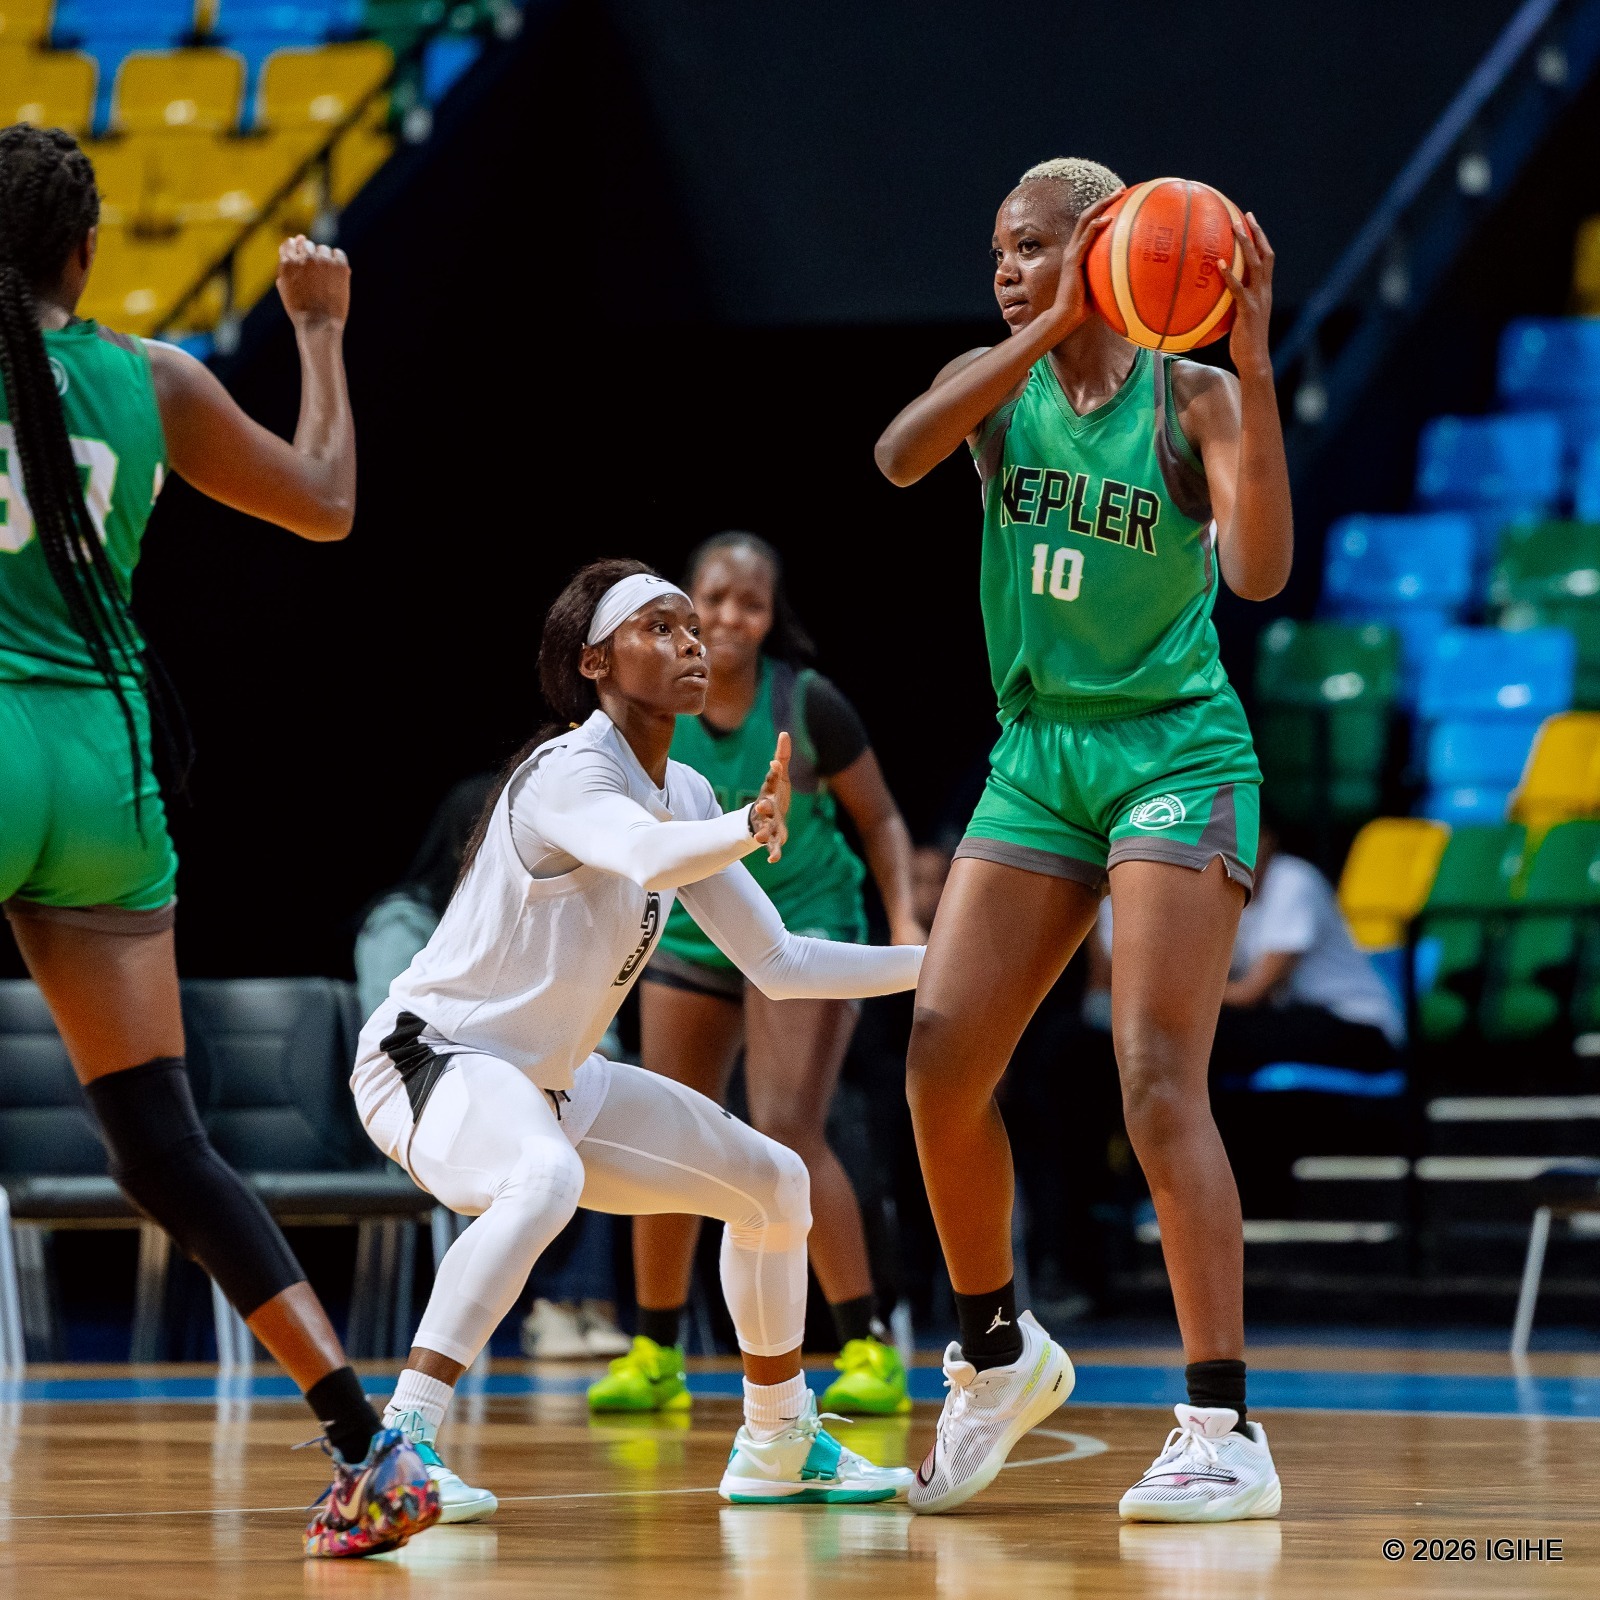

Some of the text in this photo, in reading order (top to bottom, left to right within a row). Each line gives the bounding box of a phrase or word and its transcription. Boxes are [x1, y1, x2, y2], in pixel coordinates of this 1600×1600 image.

[1151, 226, 1174, 264] FIBA
[1000, 464, 1161, 557] KEPLER
[1031, 542, 1085, 602] 10
